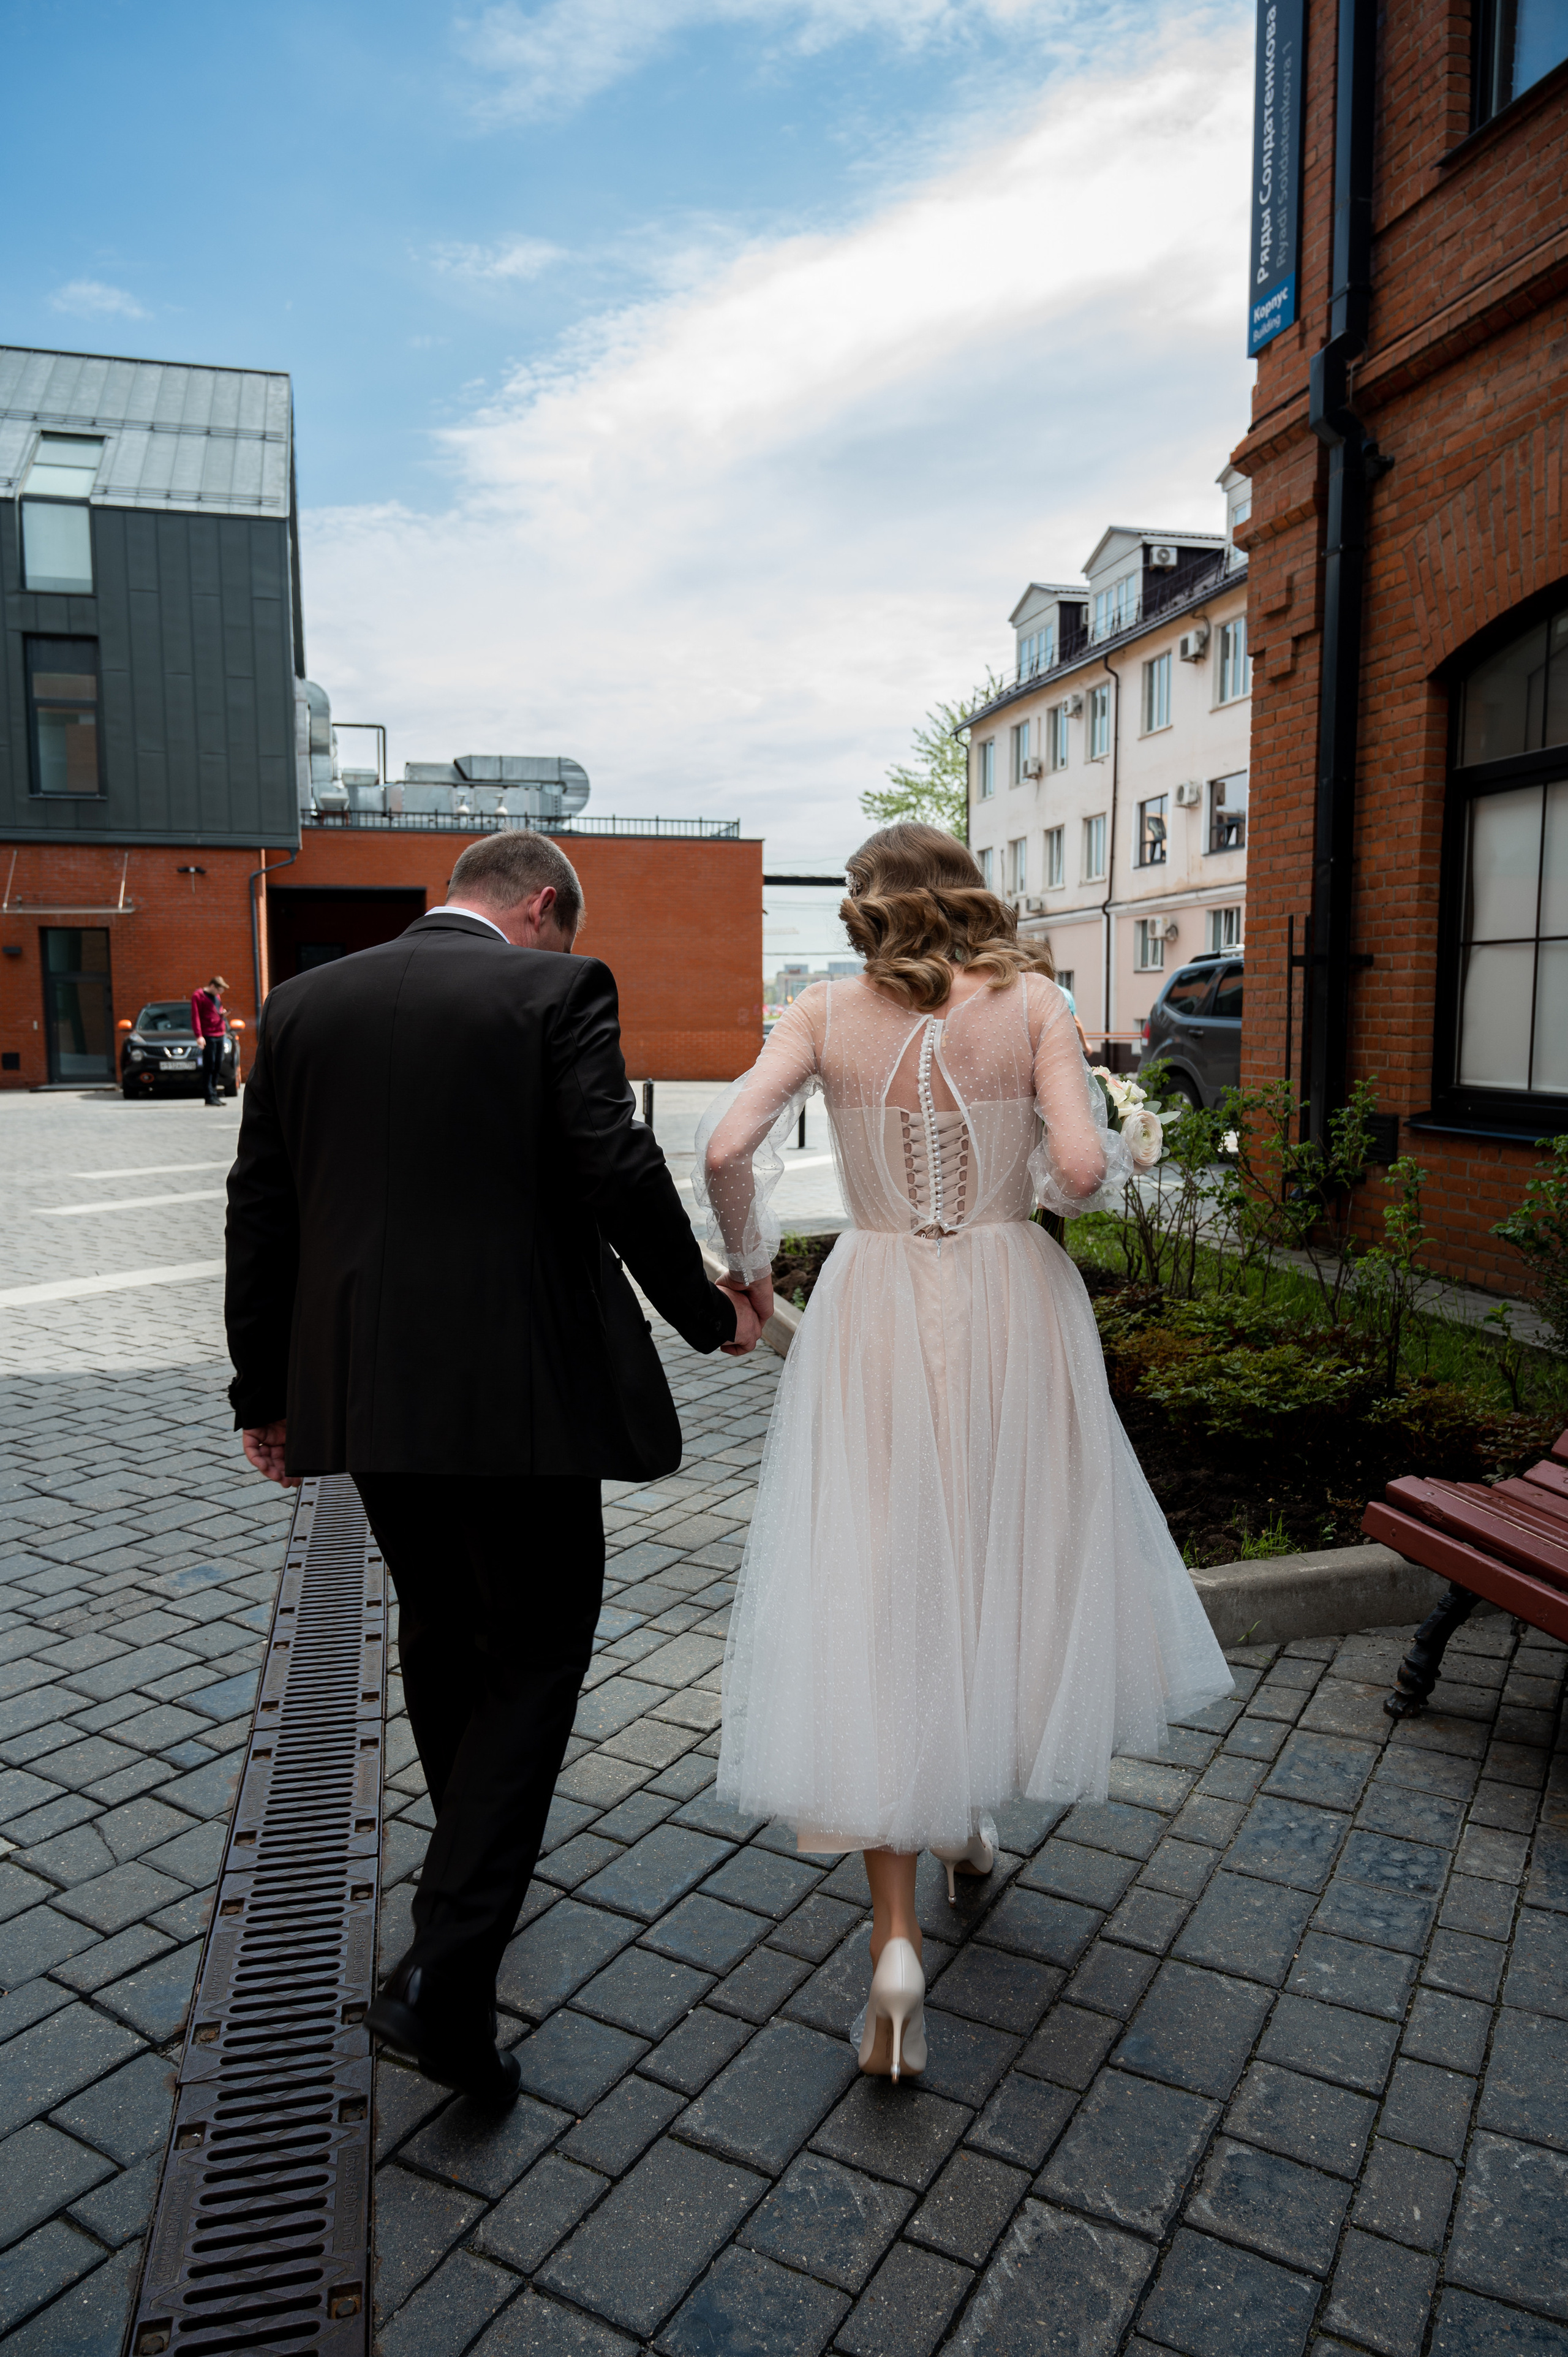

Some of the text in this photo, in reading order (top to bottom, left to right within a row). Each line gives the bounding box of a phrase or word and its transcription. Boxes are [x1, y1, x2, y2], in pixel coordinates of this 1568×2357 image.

[1257, 5, 1277, 284] Ряды Солдатенкова
[1278, 56, 1292, 205] Soldatenkova
[1276, 206, 1289, 268] Ryadi
[1253, 314, 1281, 343] Building
[1254, 286, 1288, 323] Корпус
[208, 1934, 232, 1999] GEMMADRAINAGE
[352, 1916, 367, 1982] Klass E600 DN150
[157, 2179, 188, 2280] GEMMADRAINAGE
[342, 2147, 360, 2250] Klass E600 DN150
